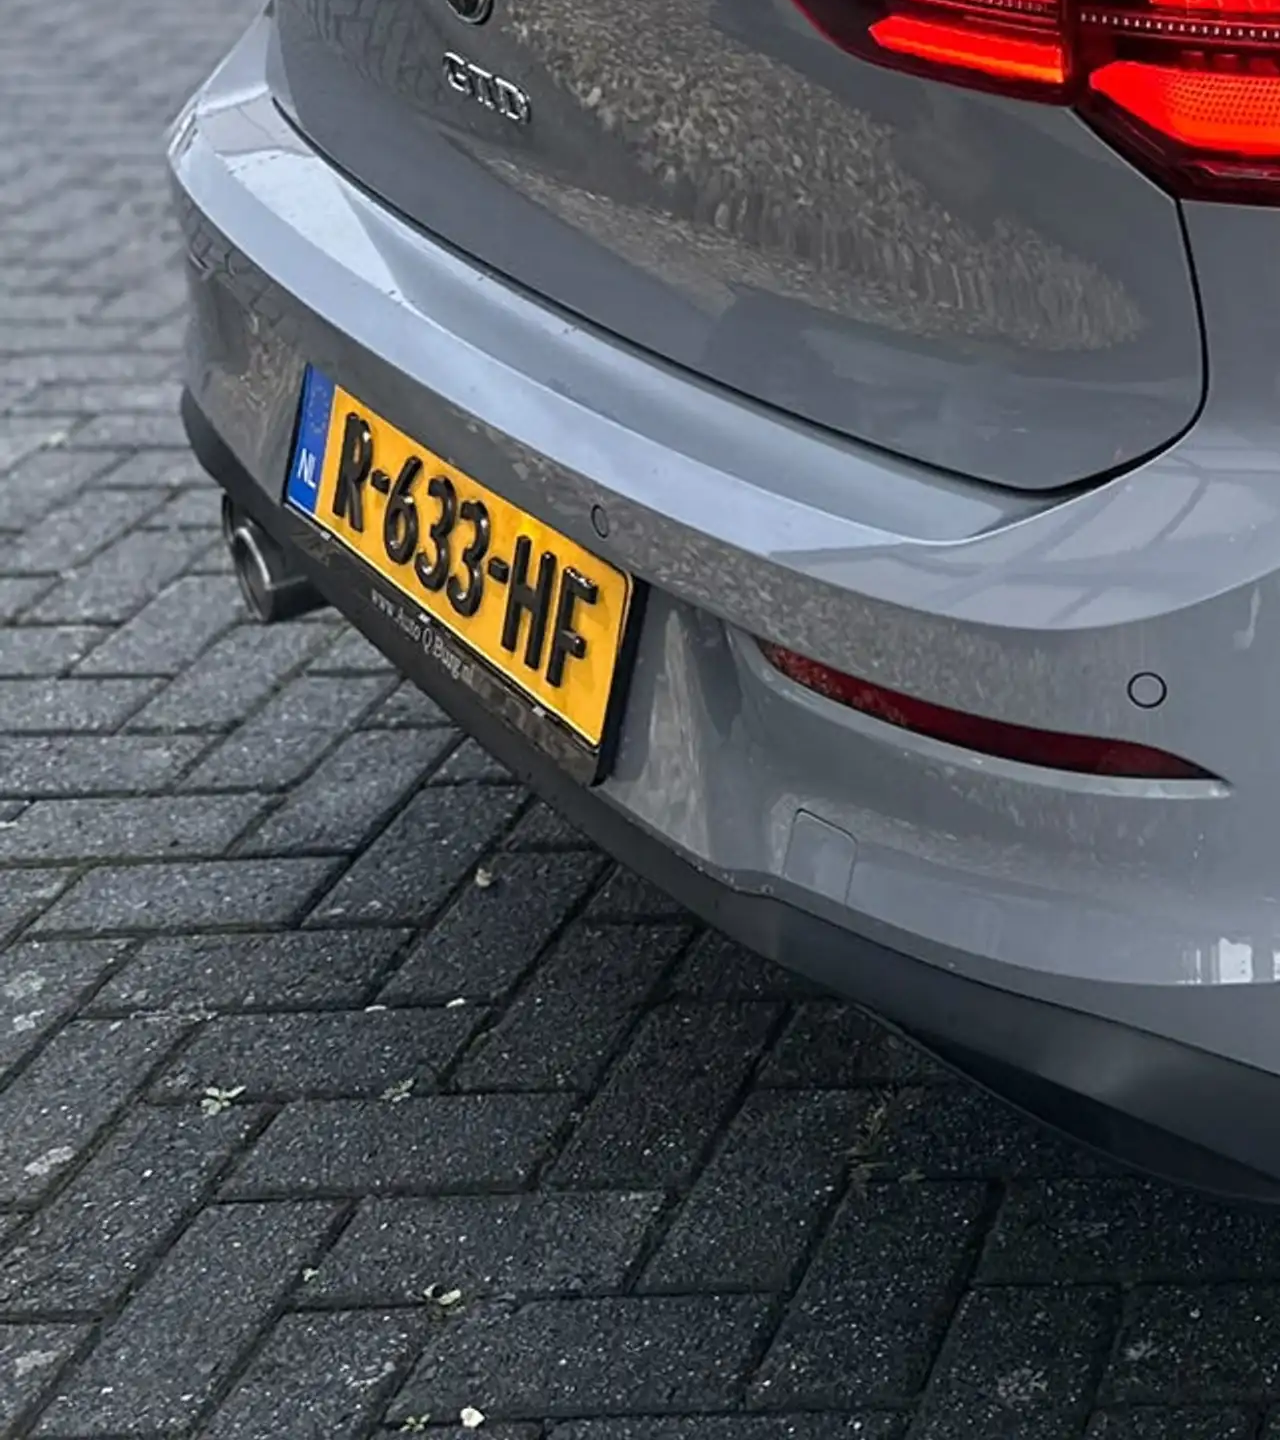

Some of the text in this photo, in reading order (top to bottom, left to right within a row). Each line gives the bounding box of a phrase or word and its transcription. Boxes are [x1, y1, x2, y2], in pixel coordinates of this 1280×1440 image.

[442, 50, 531, 125] GTD
[298, 447, 317, 490] NL
[332, 411, 600, 689] R-633-HF
